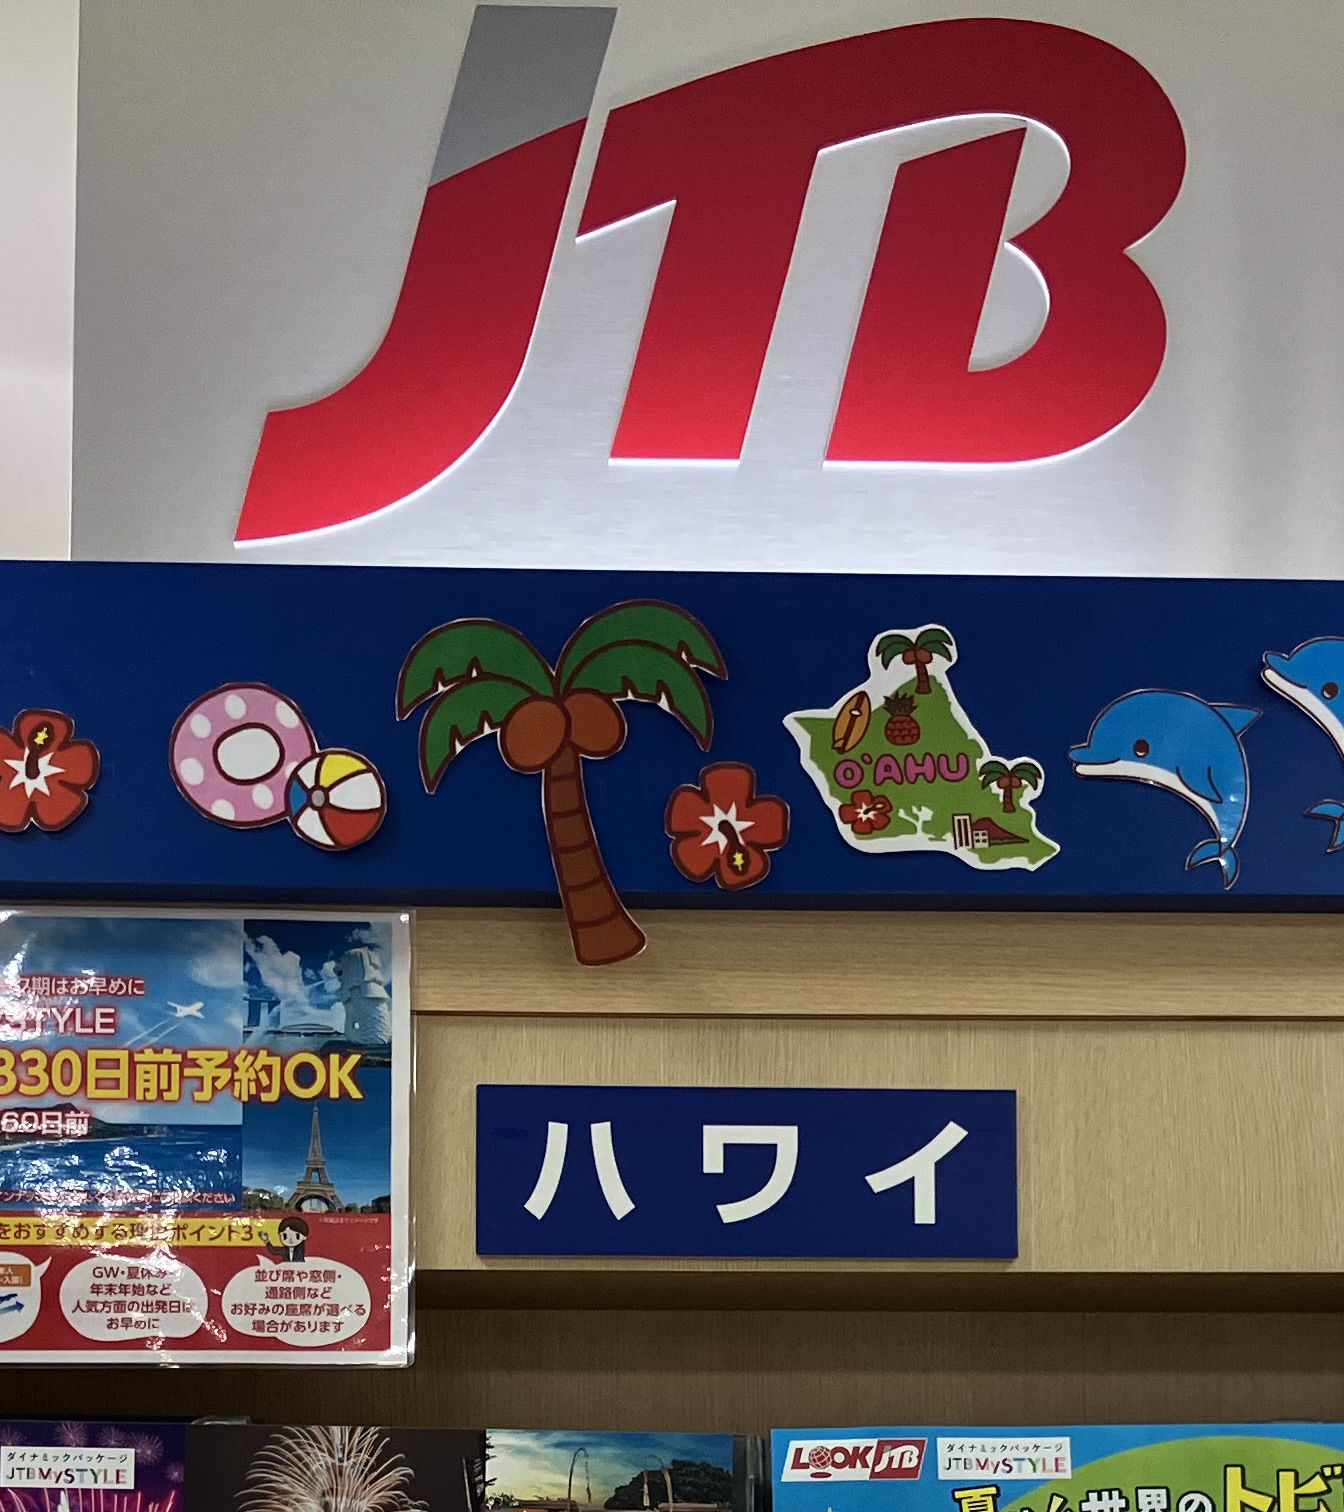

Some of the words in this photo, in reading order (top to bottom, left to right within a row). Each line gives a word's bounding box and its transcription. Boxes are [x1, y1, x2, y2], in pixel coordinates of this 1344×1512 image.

[233, 5, 1187, 546] JTB
[524, 1121, 968, 1224] ハワイ
[106, 1318, 159, 1330] お早めに
